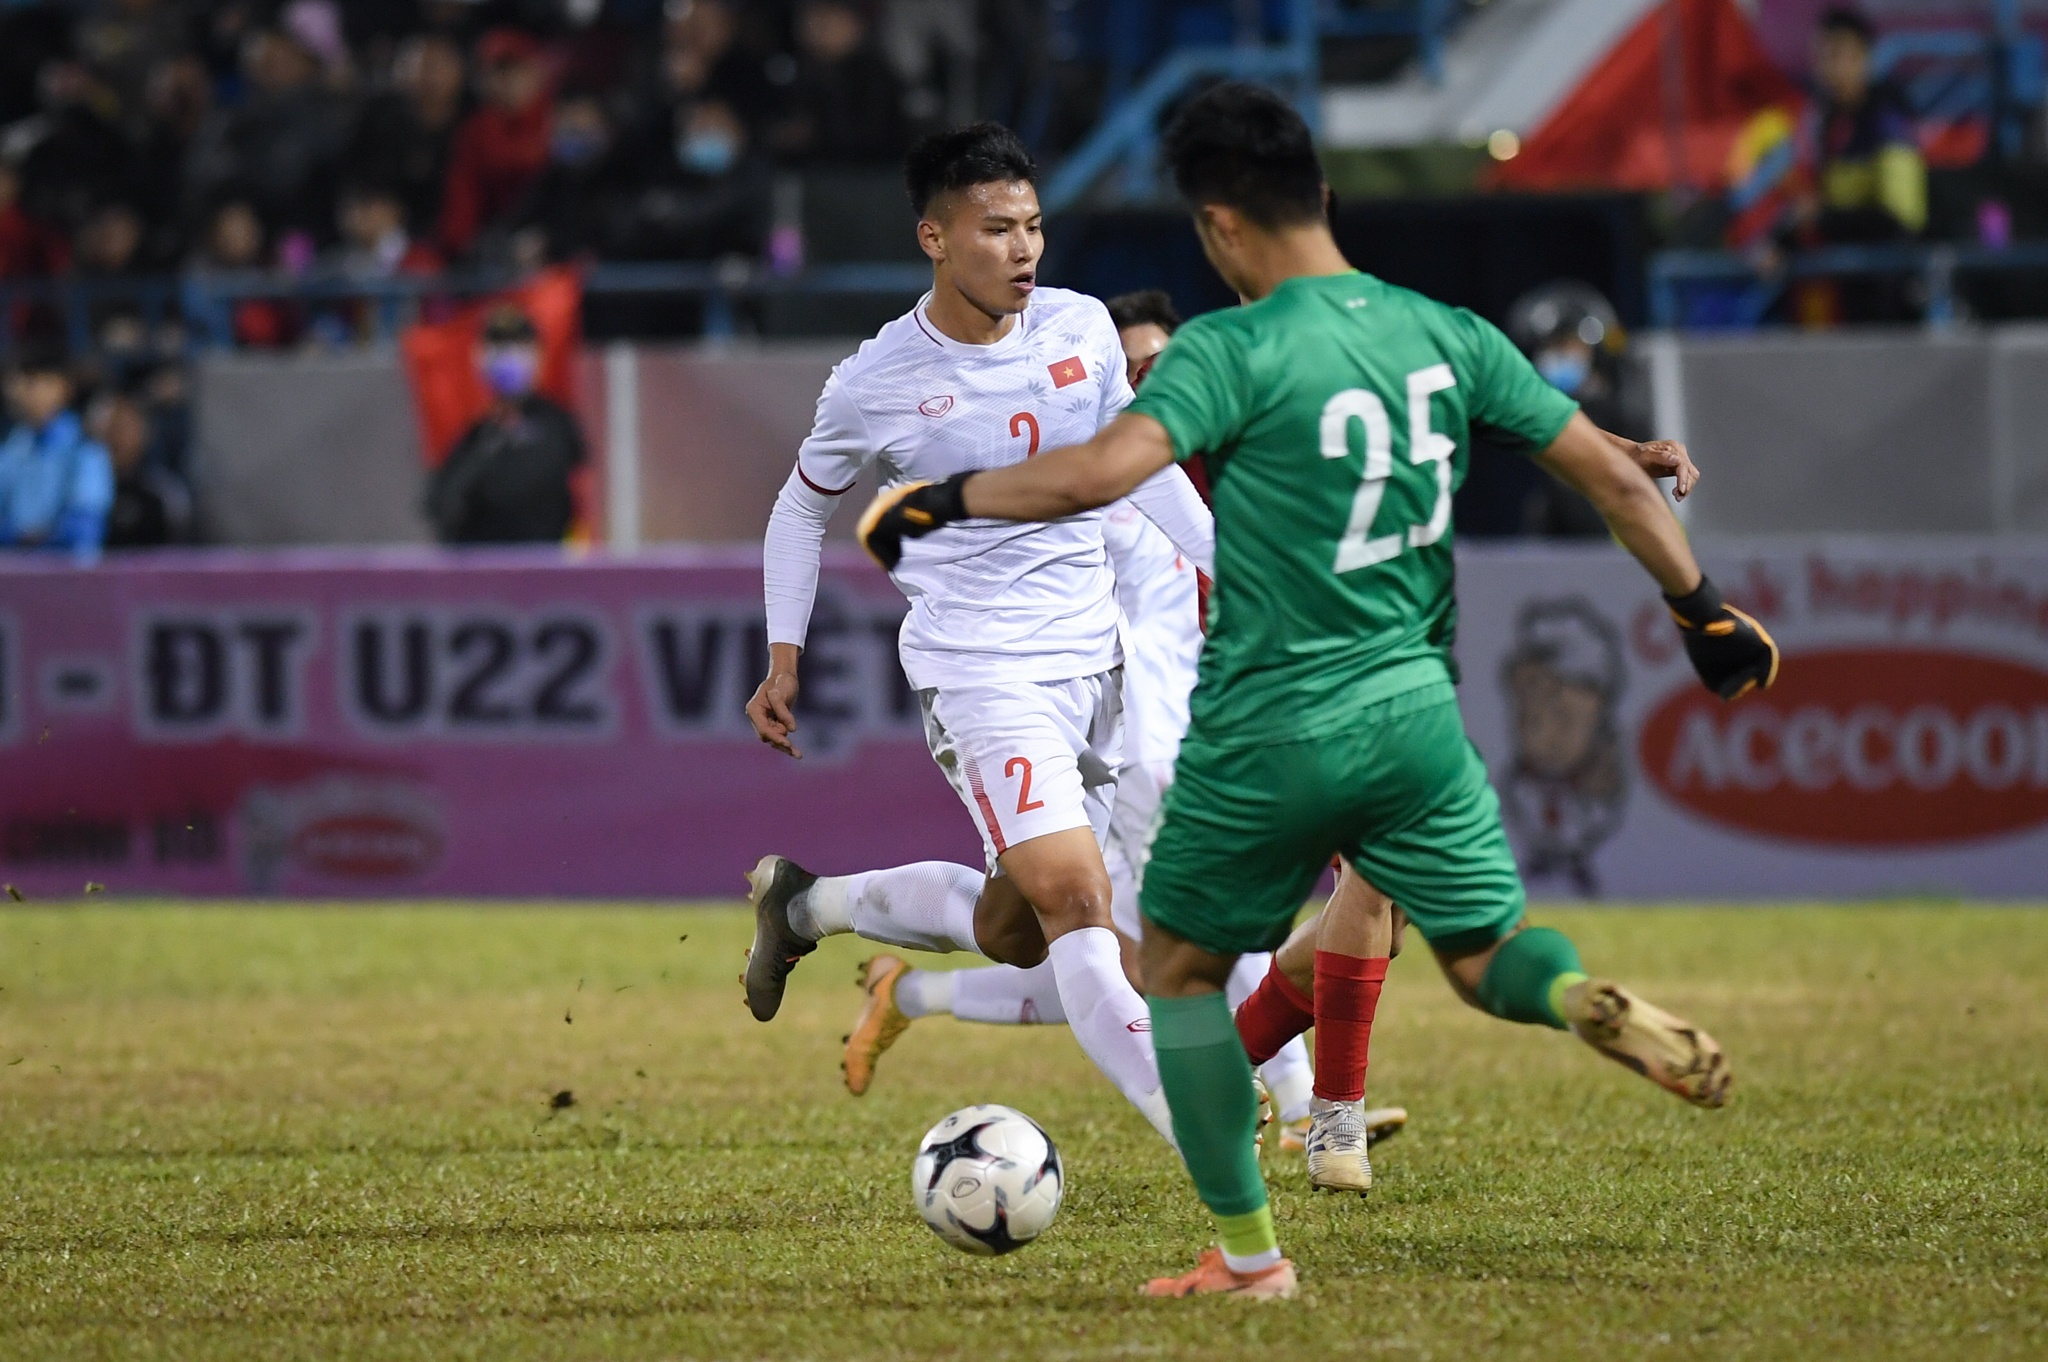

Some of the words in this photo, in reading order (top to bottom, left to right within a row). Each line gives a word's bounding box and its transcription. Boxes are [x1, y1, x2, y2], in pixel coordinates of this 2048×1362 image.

[1320, 362, 1457, 575] 25
[148, 618, 304, 727] ĐT
[356, 617, 602, 727] U22
[1004, 756, 1045, 815] 2
